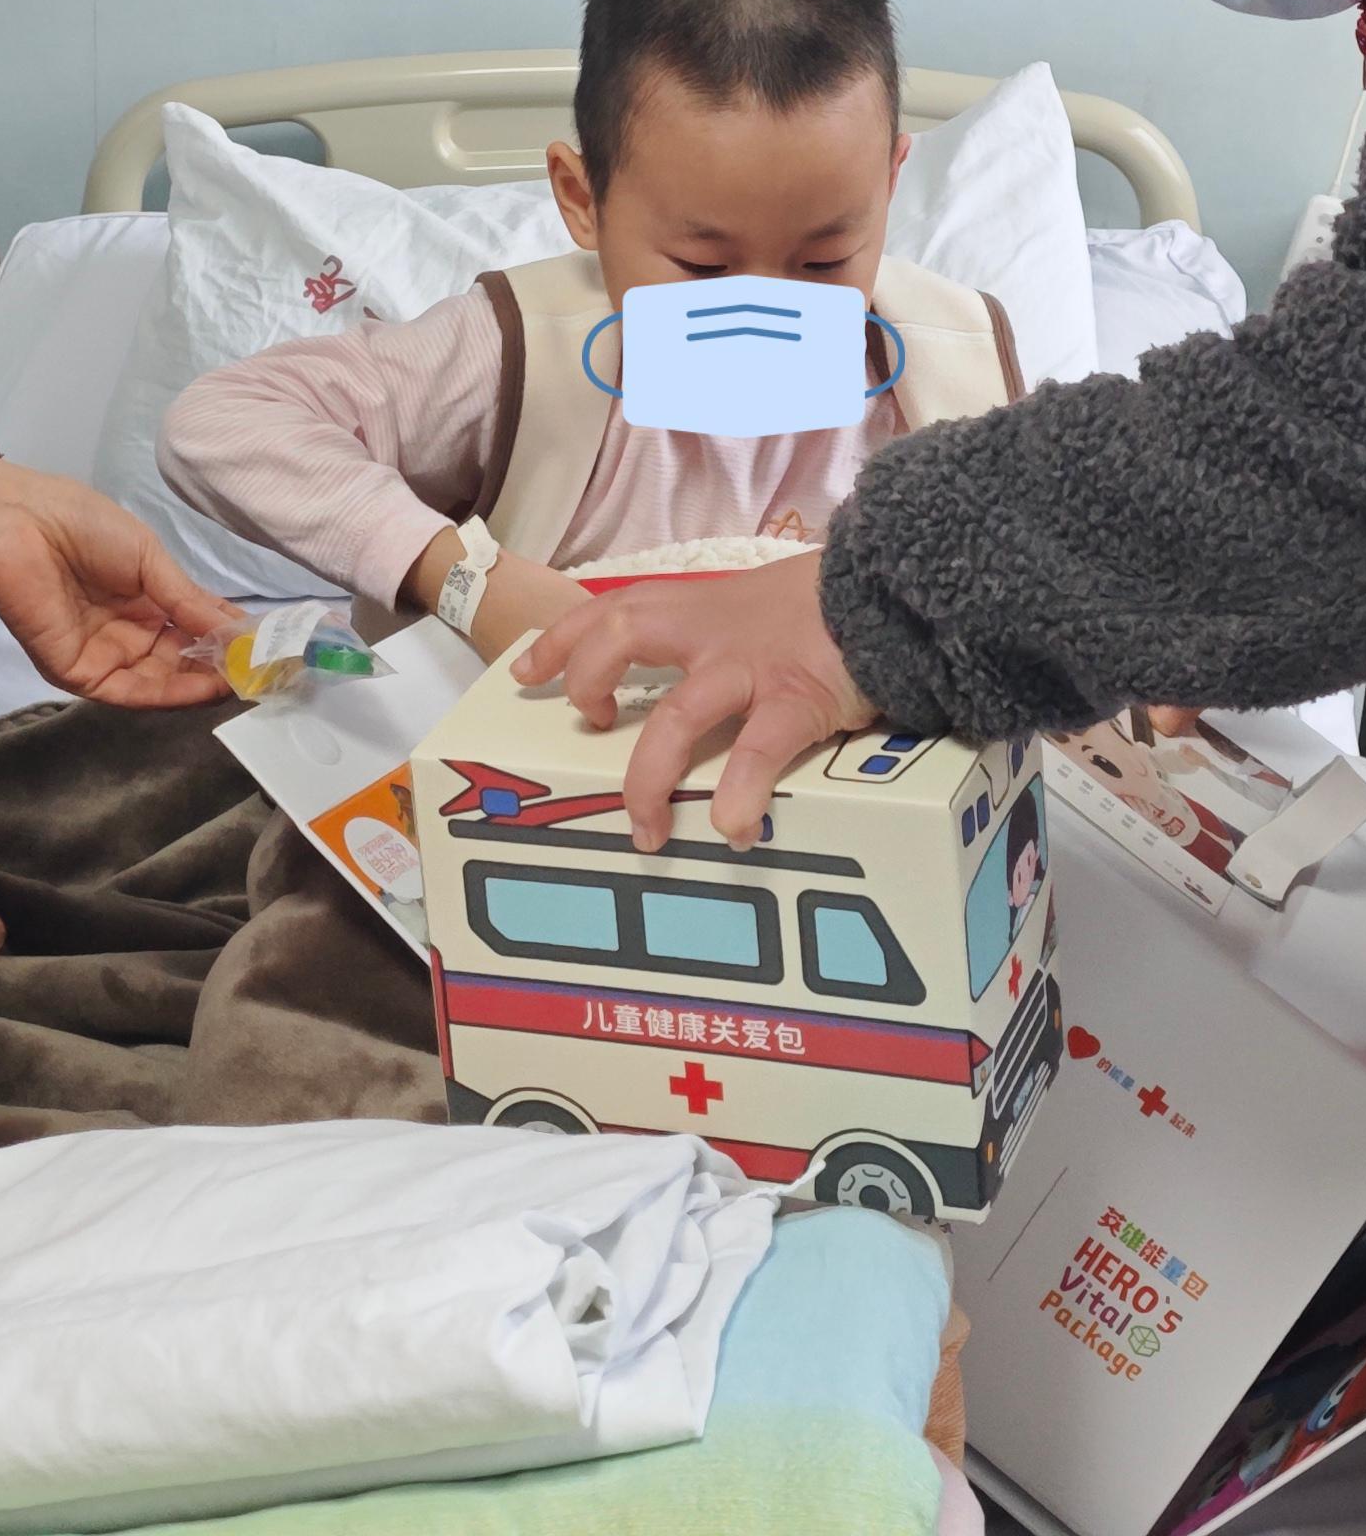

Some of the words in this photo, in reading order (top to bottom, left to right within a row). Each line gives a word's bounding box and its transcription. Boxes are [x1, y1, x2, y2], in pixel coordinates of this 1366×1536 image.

[582, 1000, 807, 1056] 儿童健康关爱包
[1169, 1110, 1198, 1139] 起来
[1097, 1205, 1209, 1302] 英雄能量包
[1038, 1290, 1143, 1383] Package
[1058, 1268, 1132, 1337] Vital
